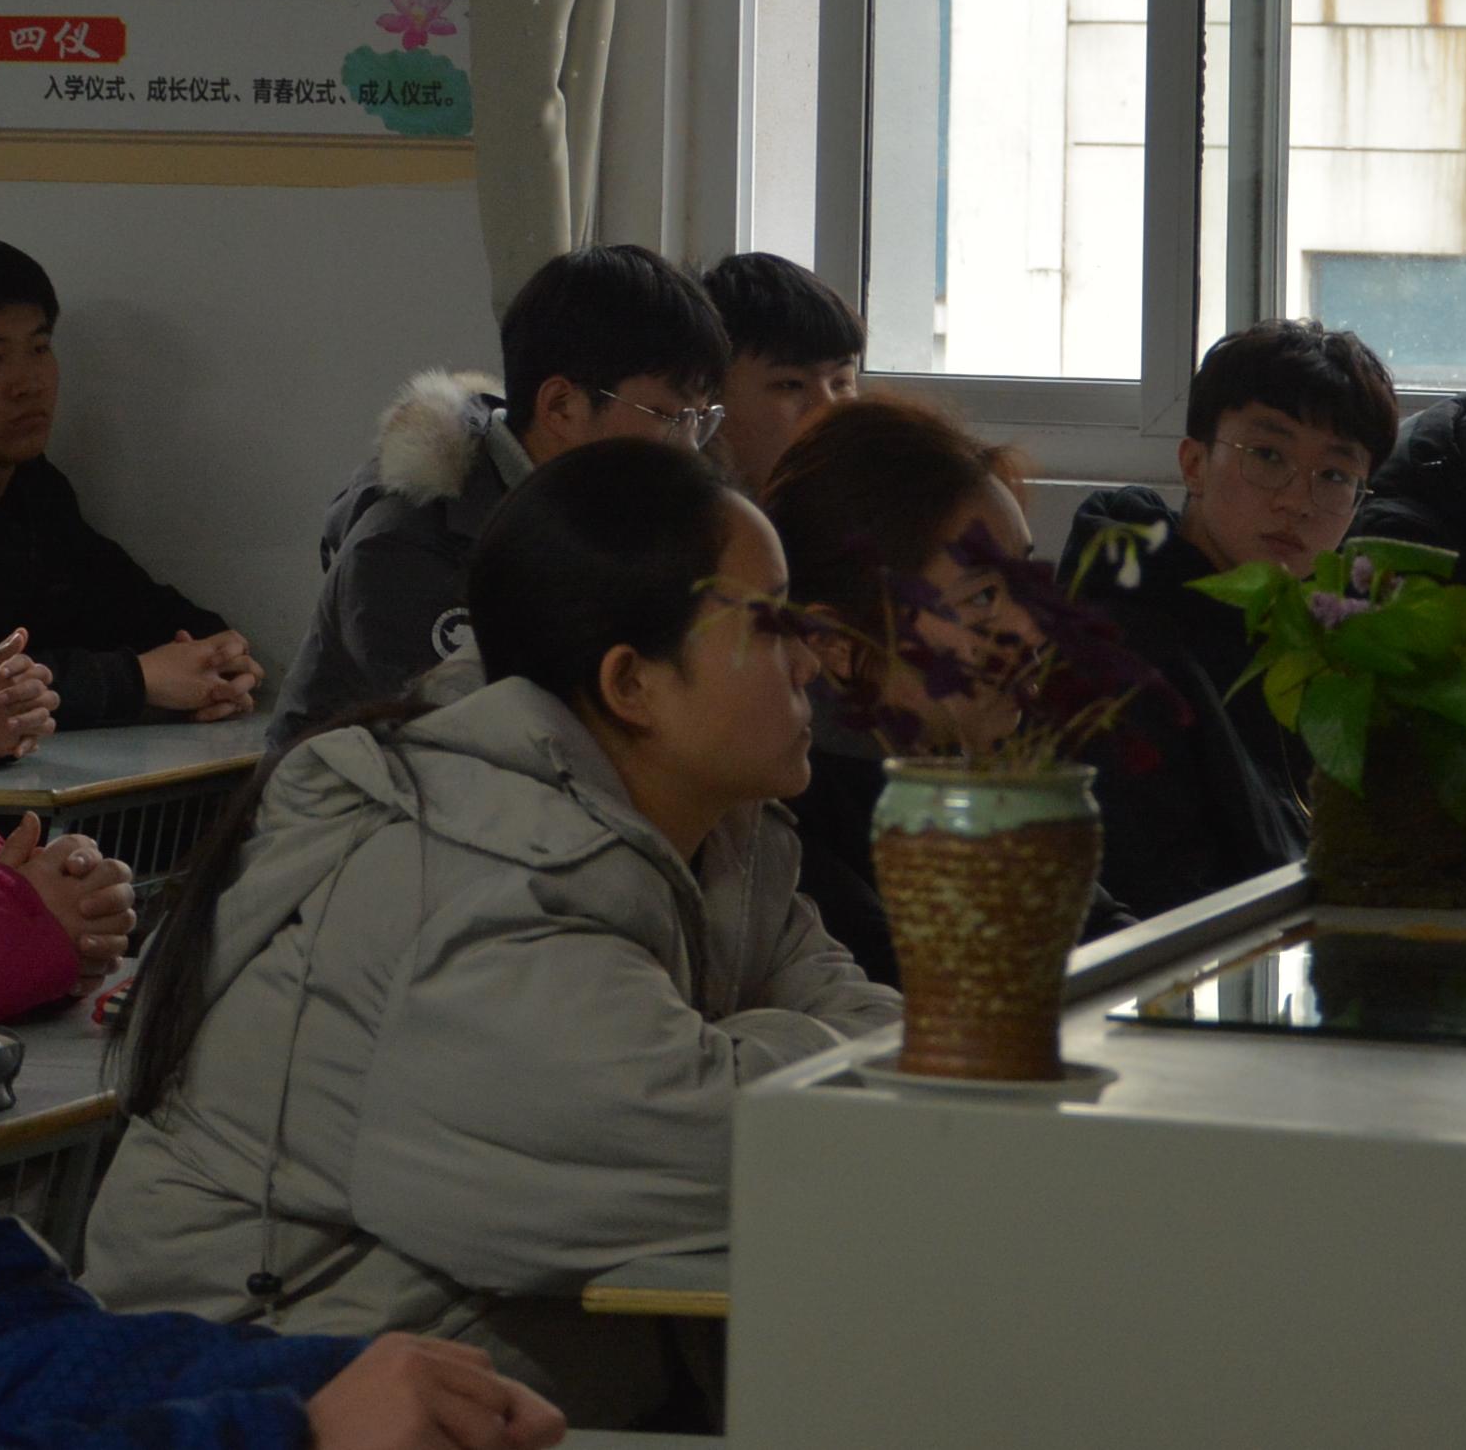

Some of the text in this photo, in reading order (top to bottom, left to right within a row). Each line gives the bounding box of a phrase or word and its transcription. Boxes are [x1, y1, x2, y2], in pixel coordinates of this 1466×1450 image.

[8, 20, 101, 61] 四仪
[43, 75, 455, 108] 入学仪式、成长仪式、青春仪式、成人仪式。
